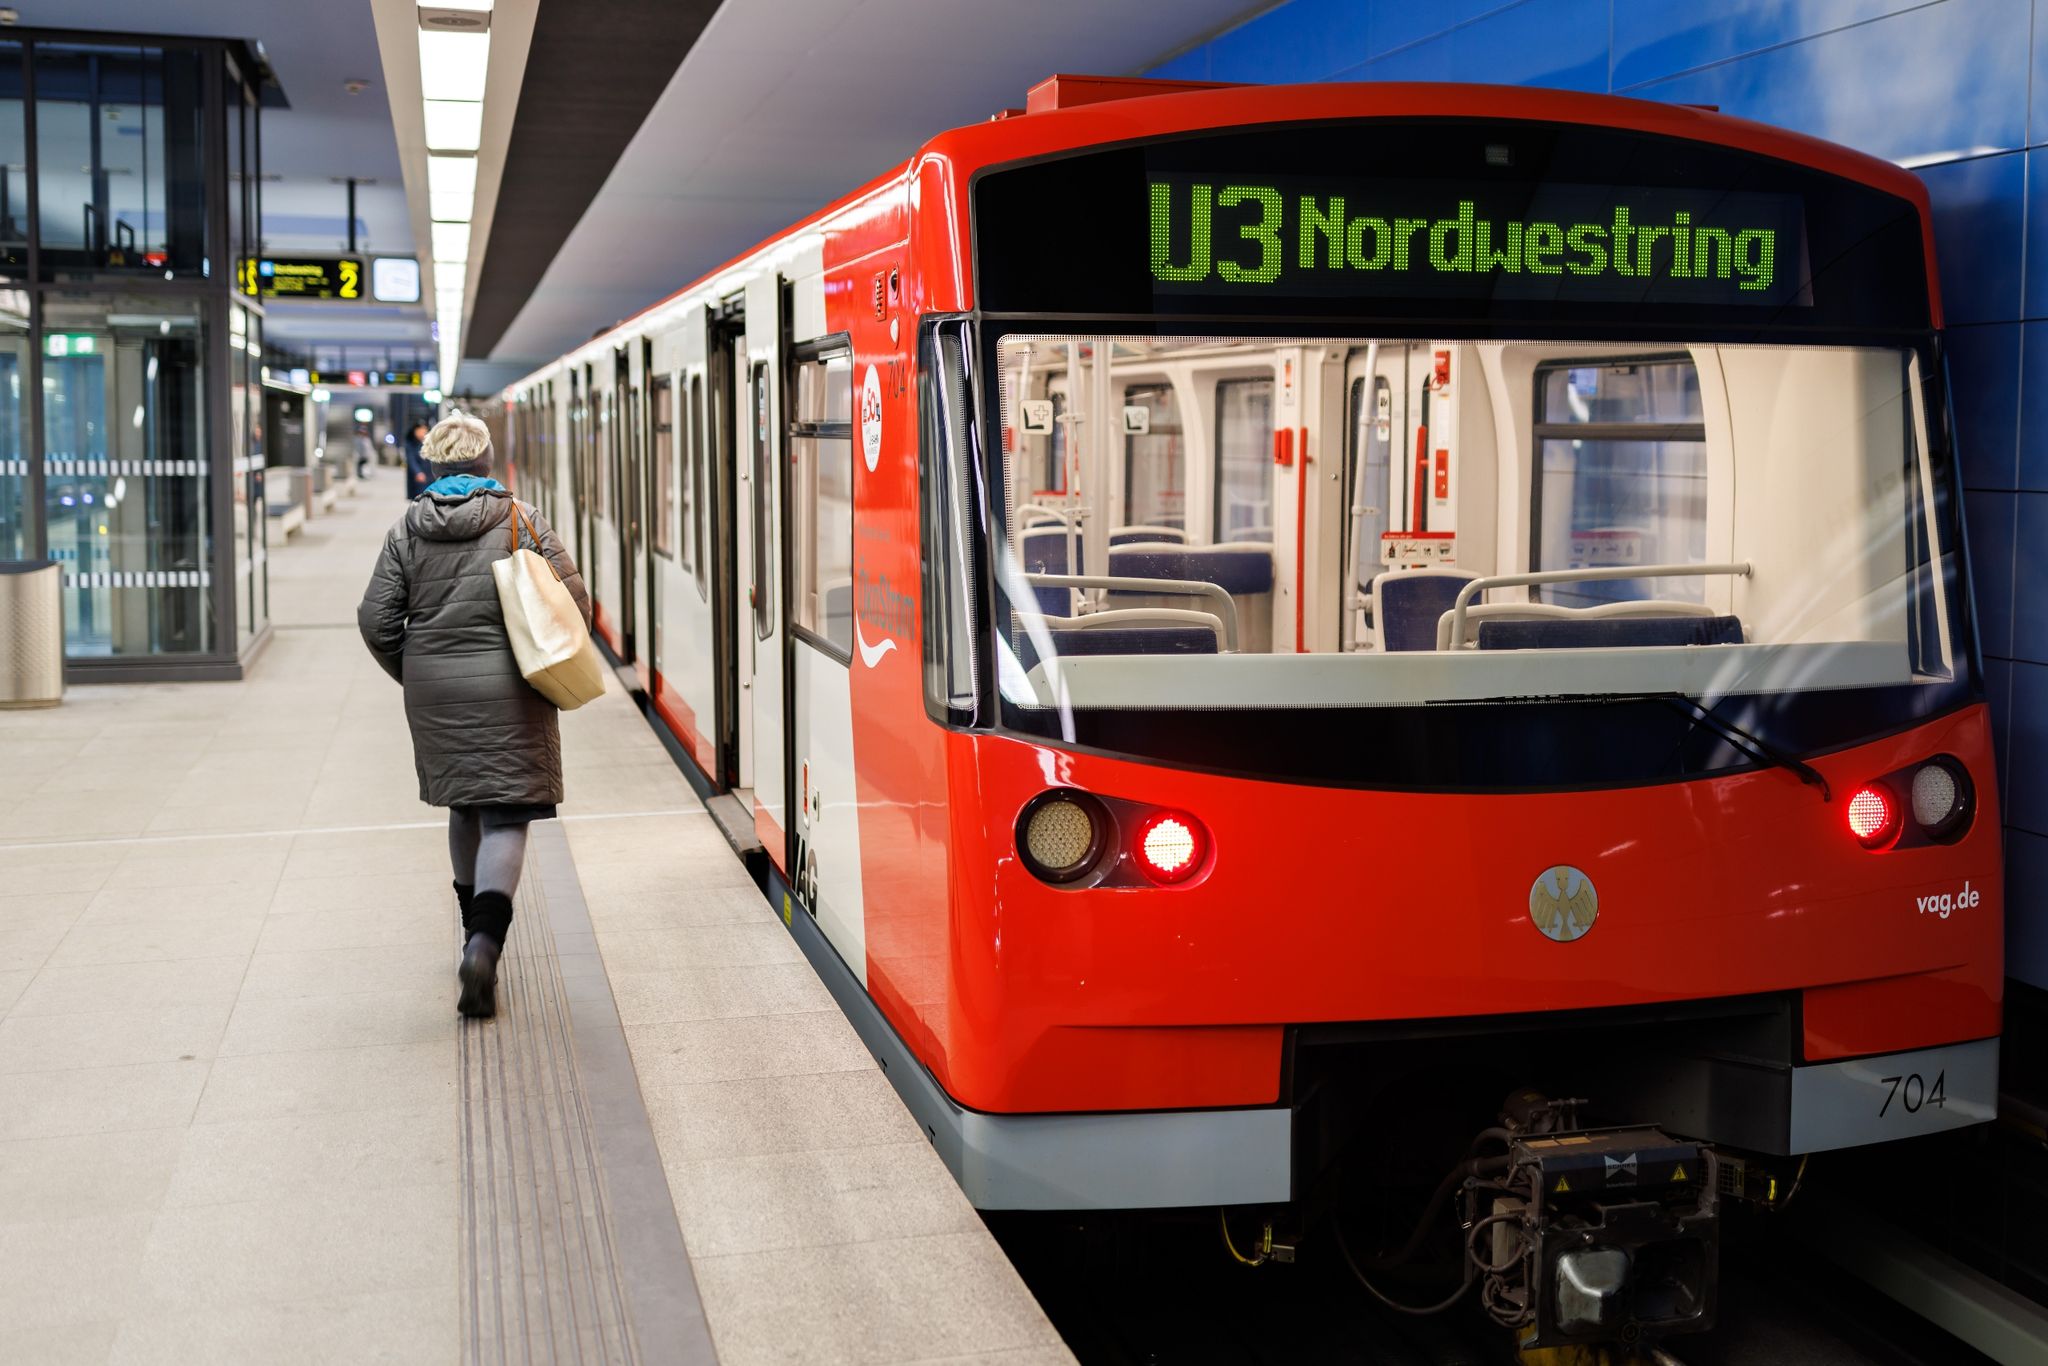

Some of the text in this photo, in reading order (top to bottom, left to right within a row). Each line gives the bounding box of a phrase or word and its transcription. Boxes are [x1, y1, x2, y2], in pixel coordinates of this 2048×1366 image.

[1150, 182, 1776, 290] U3 Nordwestring
[339, 268, 358, 298] 2
[887, 359, 906, 400] 704
[1916, 880, 1980, 919] vag.de
[1879, 1069, 1947, 1118] 704
